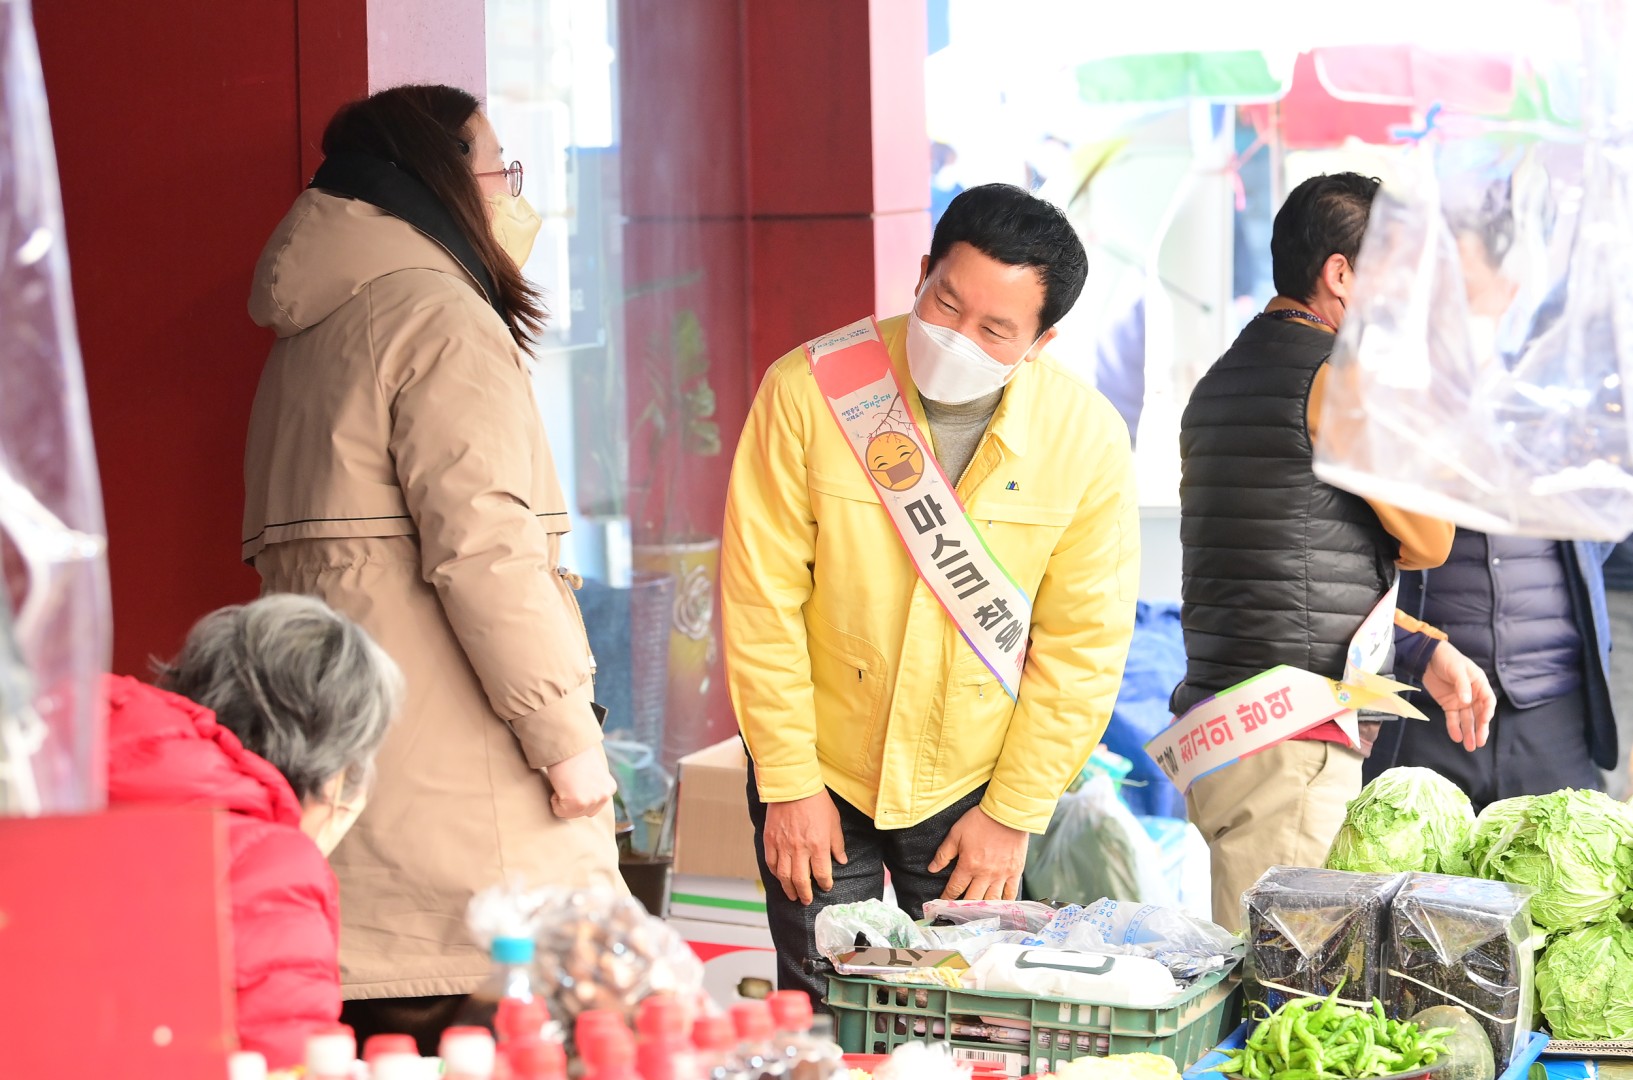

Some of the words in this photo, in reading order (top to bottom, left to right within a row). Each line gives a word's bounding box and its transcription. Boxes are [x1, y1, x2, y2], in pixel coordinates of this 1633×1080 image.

[859, 393, 892, 410] 해운대
[904, 493, 990, 600] 마스크
[972, 597, 1024, 654] 착용
[1178, 714, 1234, 764] 최고의
[1236, 686, 1294, 734] 방역
